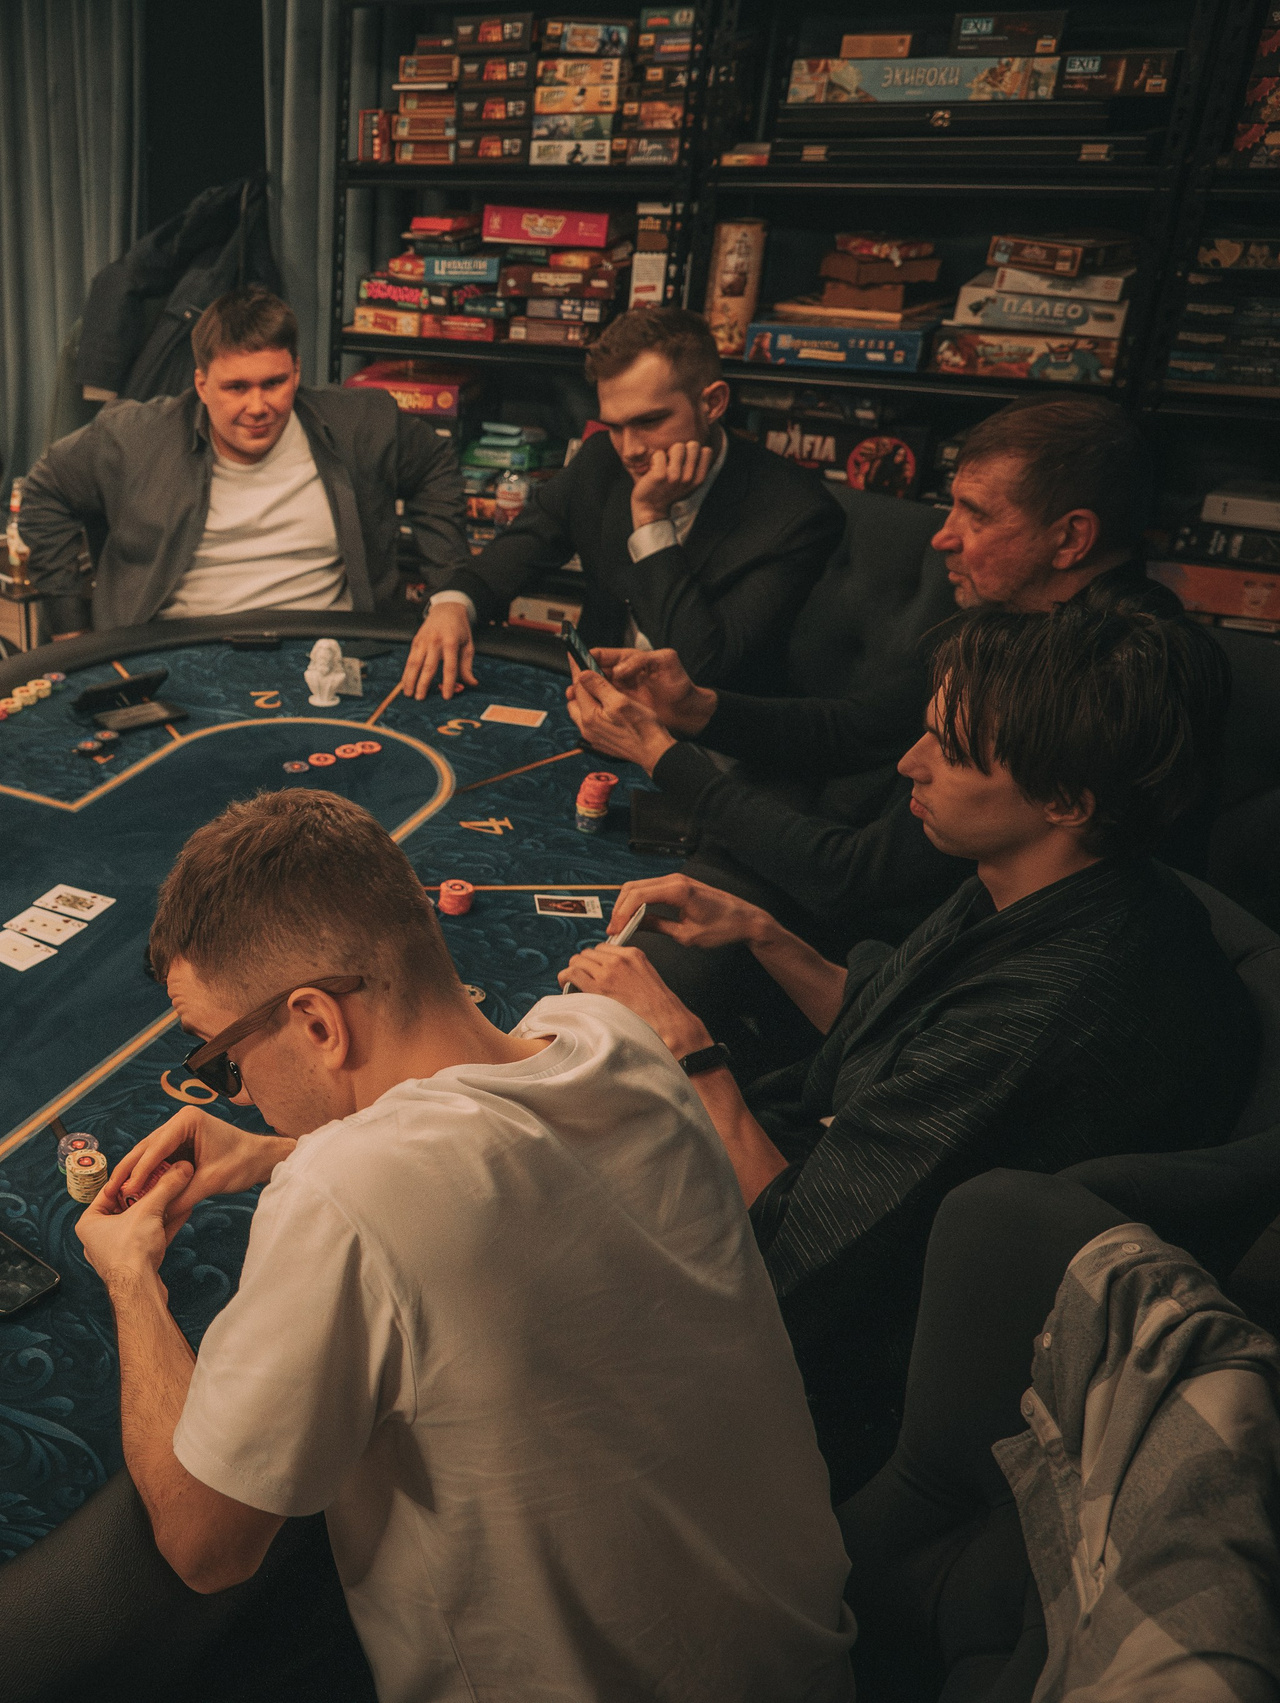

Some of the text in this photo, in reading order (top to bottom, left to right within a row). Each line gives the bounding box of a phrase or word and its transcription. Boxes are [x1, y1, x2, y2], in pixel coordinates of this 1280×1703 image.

[961, 18, 991, 33] EXIT
[1067, 56, 1099, 70] EXIT
[881, 66, 961, 88] ЭКИВОКИ
[1002, 297, 1084, 319] ПАЛЕО
[249, 690, 283, 710] 2
[436, 717, 482, 737] 3
[459, 817, 515, 836] 4
[160, 1069, 220, 1106] 6
